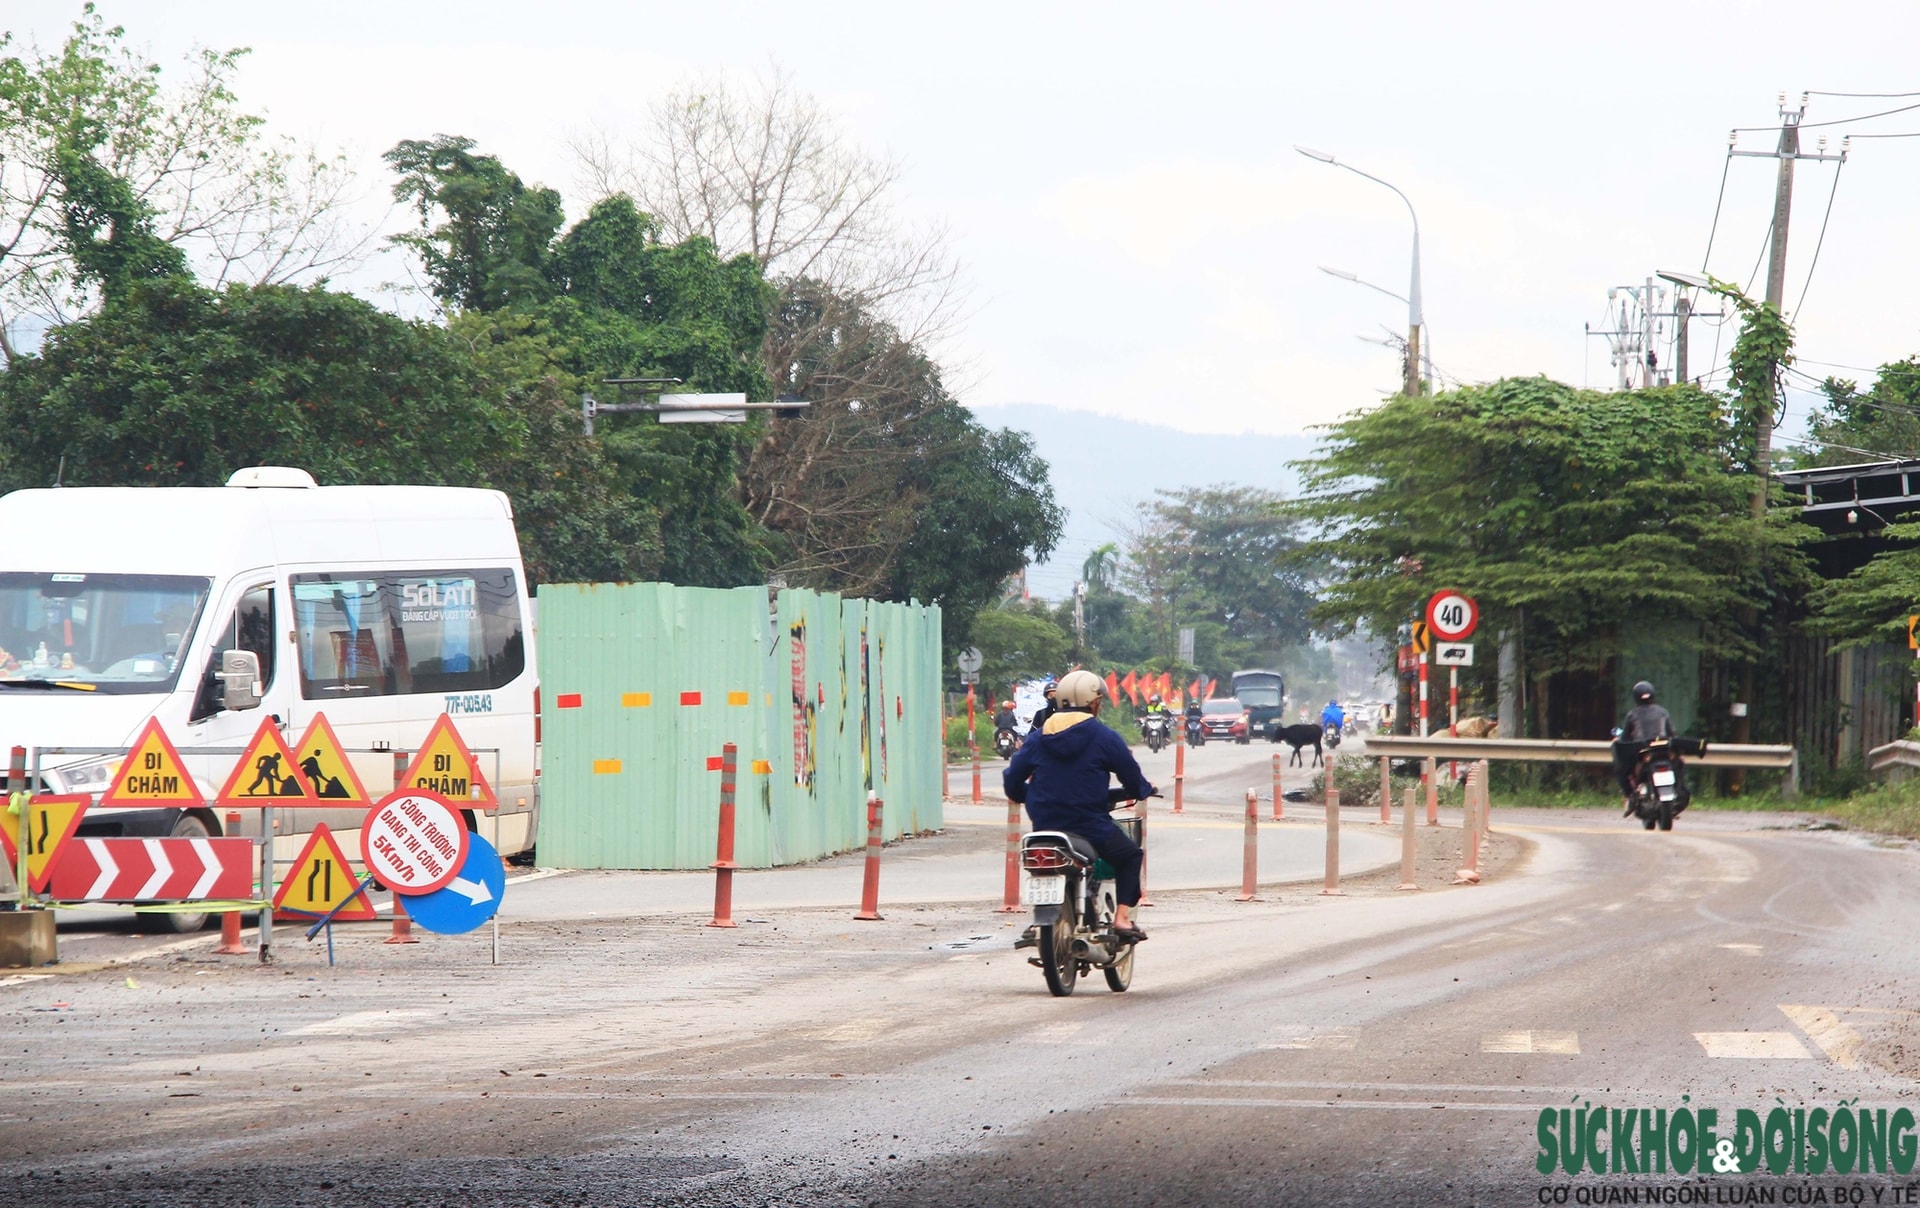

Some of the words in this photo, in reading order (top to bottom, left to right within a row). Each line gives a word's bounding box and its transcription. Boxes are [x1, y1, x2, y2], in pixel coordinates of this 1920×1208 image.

[402, 584, 475, 607] SOLATI
[1441, 605, 1463, 626] 40
[145, 752, 162, 770] ĐI
[434, 754, 451, 772] ĐI
[127, 772, 178, 797] CHẬM
[400, 798, 427, 827] CÔNG
[380, 810, 408, 838] ĐANG
[402, 834, 421, 853] THI
[416, 850, 443, 878] CÔNG
[373, 835, 415, 882] 5Km/h
